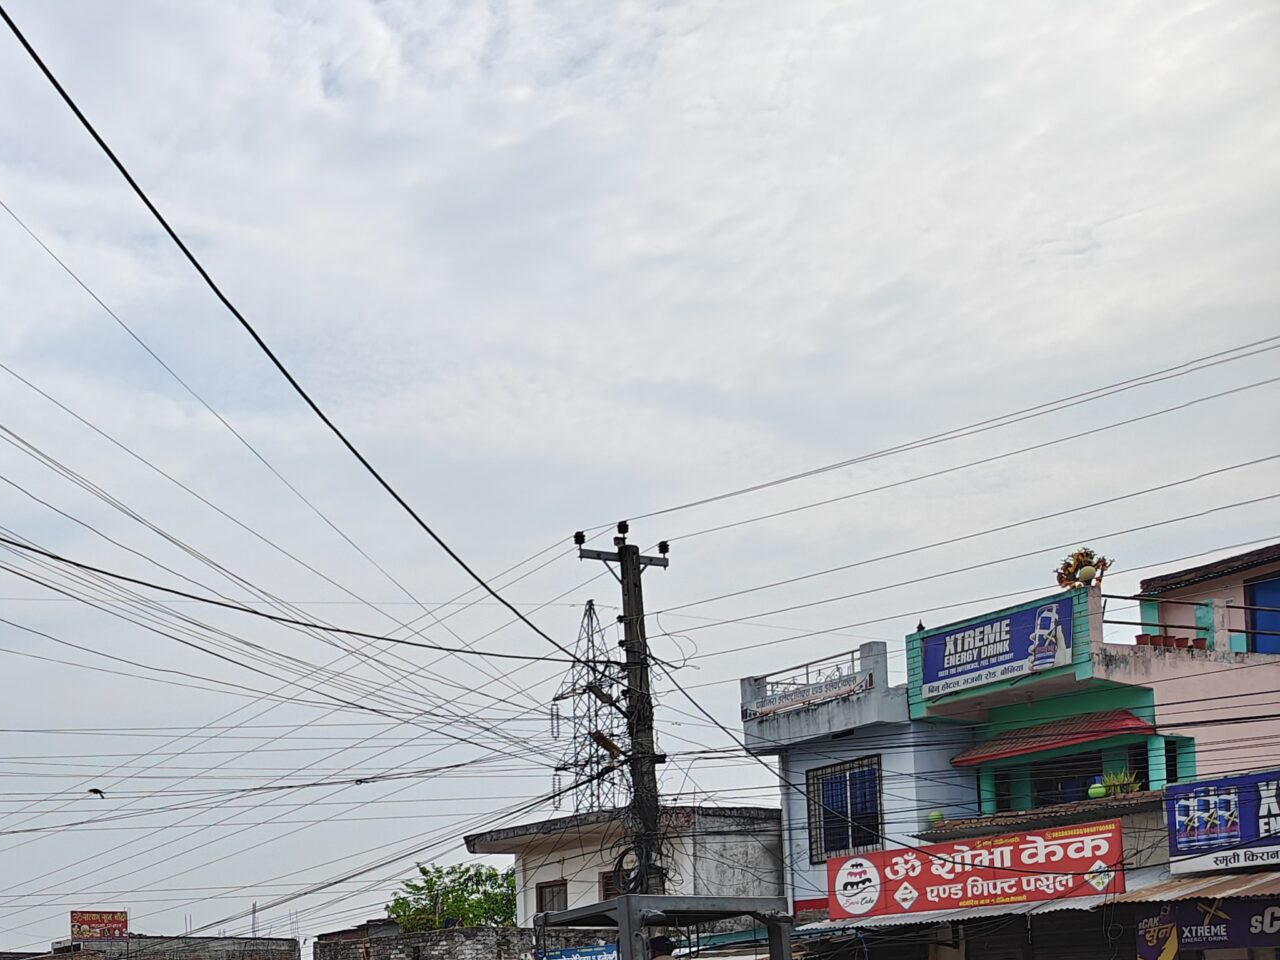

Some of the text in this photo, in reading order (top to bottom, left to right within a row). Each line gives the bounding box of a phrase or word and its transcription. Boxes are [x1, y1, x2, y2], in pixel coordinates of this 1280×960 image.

[945, 619, 1010, 656] XTREME
[944, 640, 1010, 668] ENERGY DRINK
[1257, 780, 1280, 817] X
[929, 844, 1014, 880] शोभा
[1018, 832, 1113, 865] केक
[1213, 851, 1240, 867] स्मृती
[926, 882, 964, 903] एण्ड
[966, 876, 1019, 898] गिफ्ट
[1182, 924, 1228, 938] XTREME
